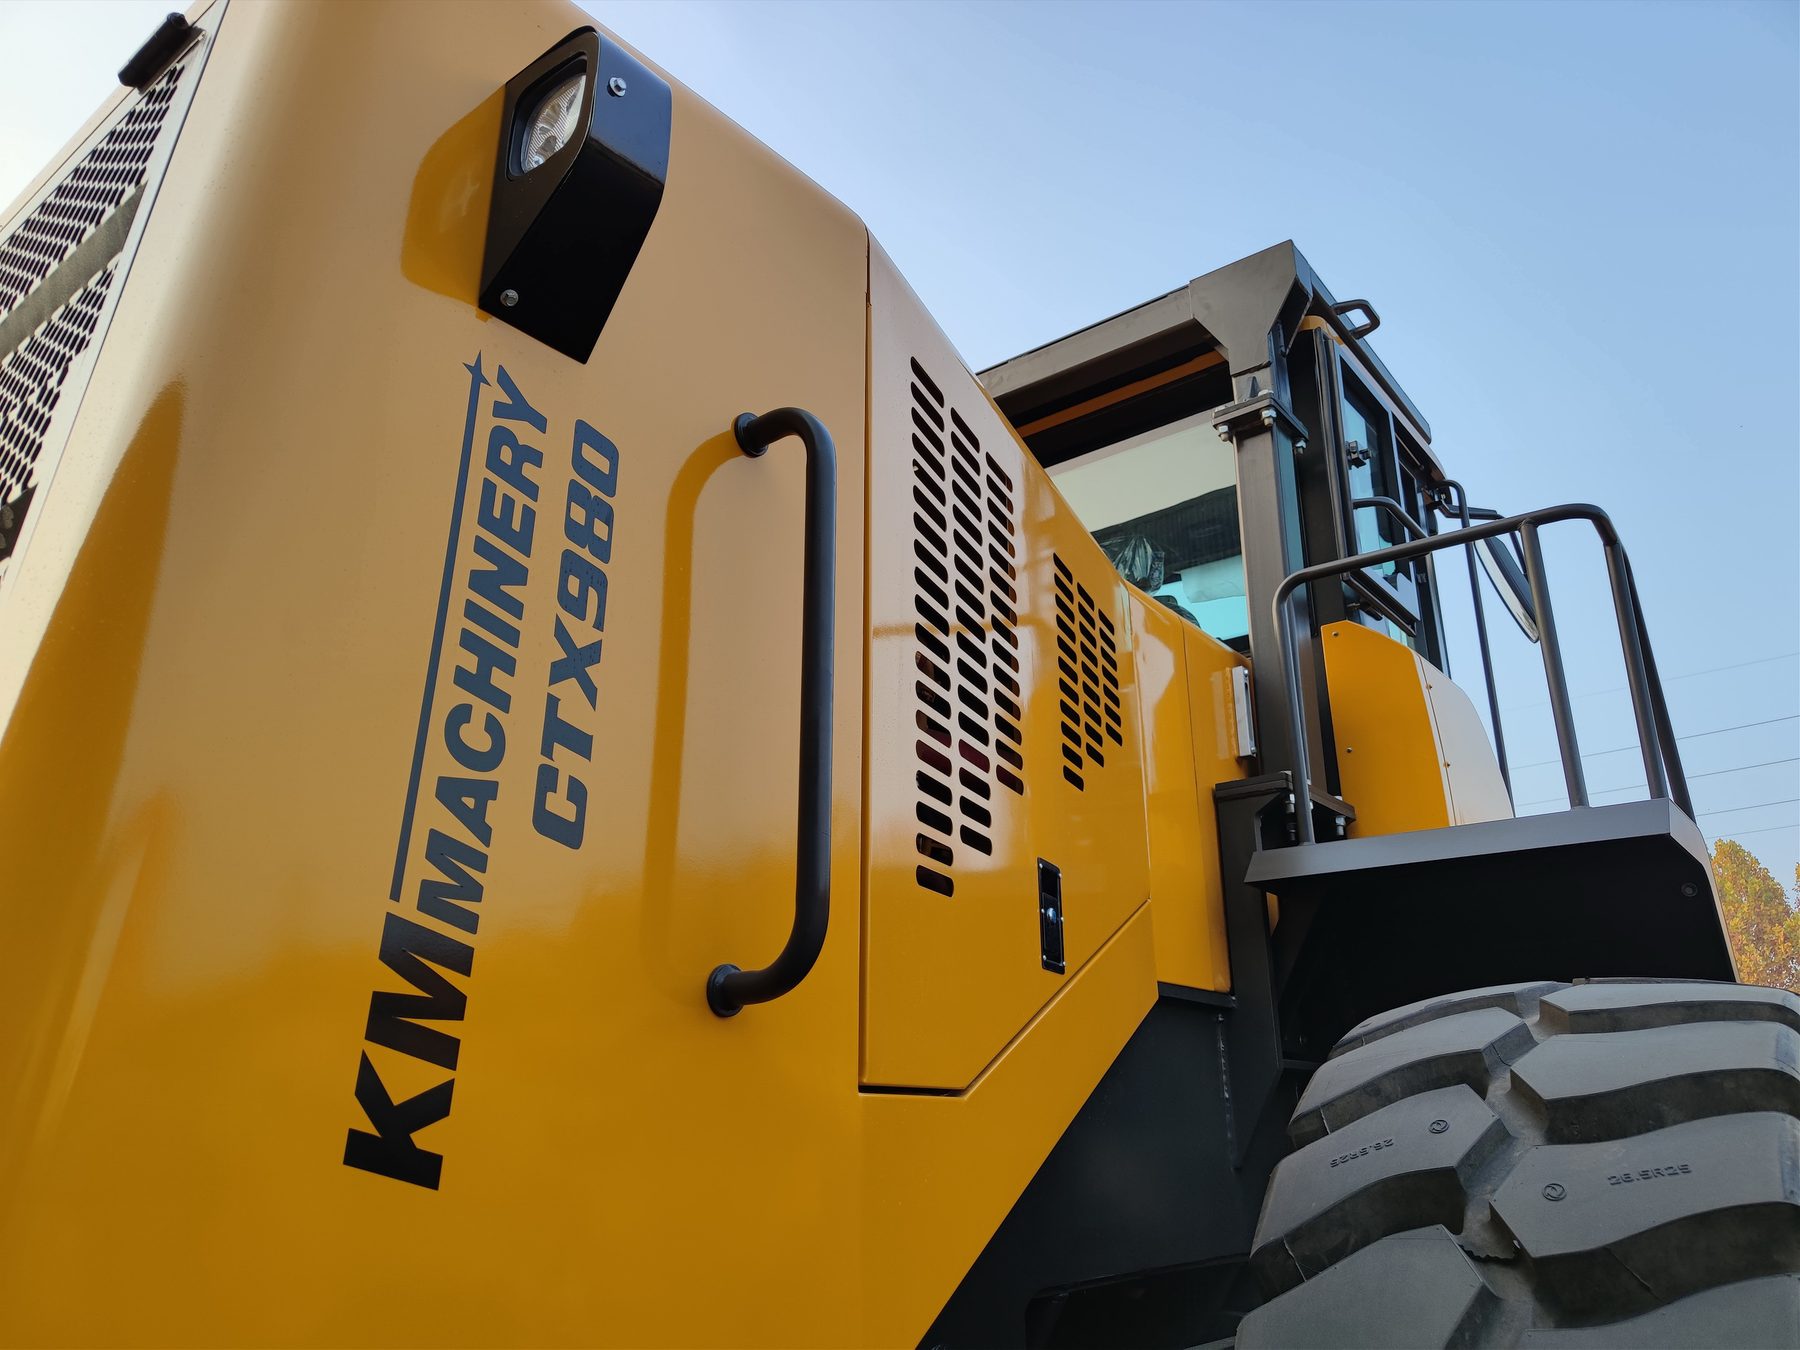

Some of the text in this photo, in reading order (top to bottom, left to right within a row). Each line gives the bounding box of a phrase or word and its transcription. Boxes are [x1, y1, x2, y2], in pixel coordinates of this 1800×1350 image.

[417, 364, 548, 933] MACHINERY
[532, 418, 620, 849] CTX980
[1329, 1138, 1395, 1168] 26.5R25
[1607, 1163, 1692, 1187] 26.5R25
